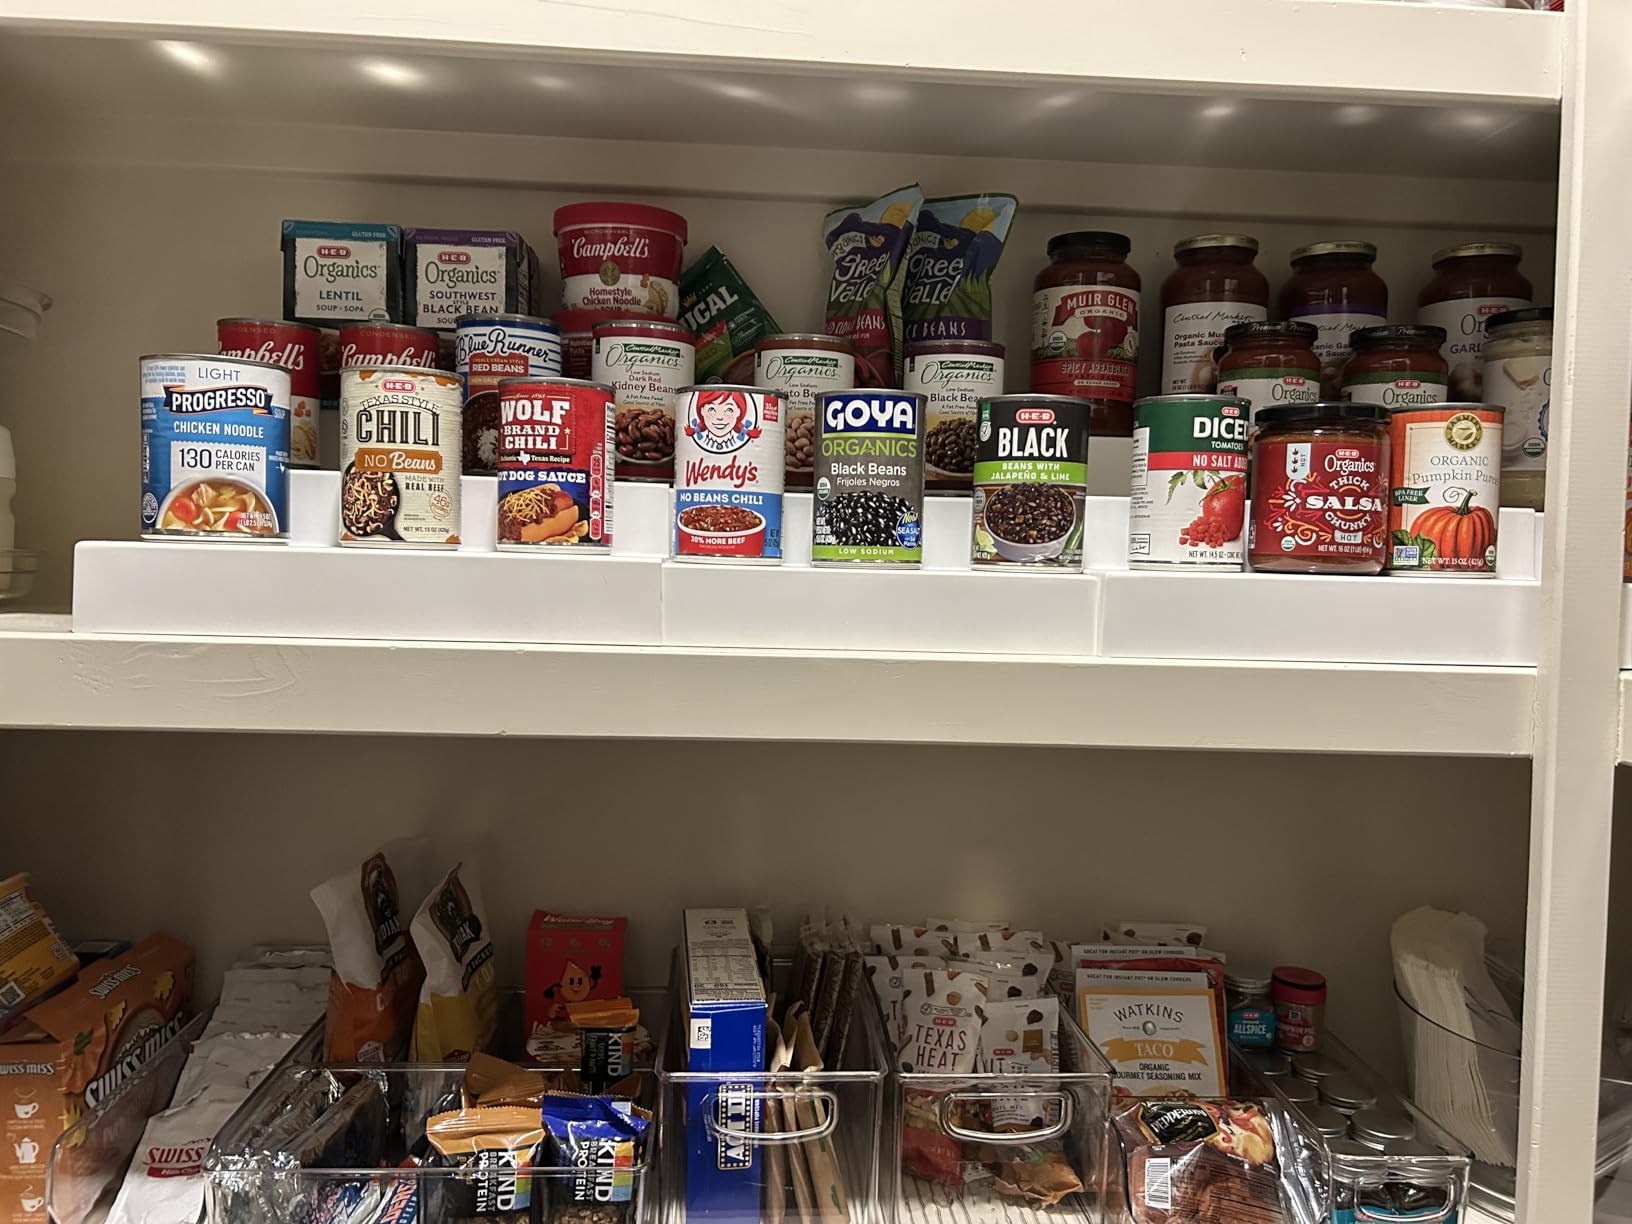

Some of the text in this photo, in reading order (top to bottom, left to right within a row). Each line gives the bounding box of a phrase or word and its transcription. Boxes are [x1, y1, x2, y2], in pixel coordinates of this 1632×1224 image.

[572, 236, 649, 260] Campbell's
[304, 256, 377, 283] Organics
[425, 262, 497, 288] Organics
[319, 290, 363, 301] LENTIL
[429, 290, 496, 300] SOUTHWEST
[590, 288, 632, 298] Homestyle
[316, 304, 338, 312] SOUP
[423, 304, 498, 314] BLACK BEAN
[582, 297, 642, 306] Chicken Noodle
[1067, 294, 1134, 315] MUIR GLEN
[1080, 308, 1124, 318] ORGANIC
[1174, 312, 1254, 324] Central Market
[922, 321, 966, 337] BEANS
[1174, 332, 1205, 340] Organic
[456, 328, 550, 366] Blue Runner
[1174, 340, 1195, 348] Pasta
[606, 344, 678, 372] Organics
[1325, 350, 1352, 358] Sauce
[198, 367, 240, 382] LIGHT
[472, 364, 524, 374] RED BEANS
[766, 357, 838, 384] Organics
[921, 362, 992, 388] Organics
[1062, 362, 1086, 374] SPICY
[612, 381, 646, 393] Kidney
[1272, 384, 1318, 404] Organics
[172, 387, 266, 412] PROGRESSO
[360, 395, 440, 413] TEXAS STYLE
[930, 393, 958, 402] Black
[1383, 388, 1436, 406] Organics
[500, 400, 570, 425] WOLF
[826, 400, 913, 430] GOYA
[1020, 412, 1050, 420] H-E-B
[174, 421, 264, 439] CHICKEN NOODLE
[356, 410, 440, 446] CHILI
[504, 424, 560, 436] BRAND
[1446, 414, 1480, 431] FARMERS
[505, 436, 558, 450] CHILI
[822, 439, 917, 458] ORGANICS
[998, 427, 1069, 458] BLACK
[1211, 441, 1244, 450] TOMATOES
[1448, 436, 1479, 450] MARKET
[179, 448, 212, 469] 130
[215, 449, 261, 462] CALORIES
[364, 452, 436, 470] NO Beans
[1193, 455, 1232, 468] NO SALT
[1430, 456, 1488, 466] ORGANIC
[215, 460, 255, 472] PER CAN
[686, 455, 758, 488] Wendy's
[831, 462, 907, 476] Black Beans
[1002, 462, 1032, 470] BEANS
[1325, 454, 1375, 476] Organics
[509, 471, 586, 484] DOG SAUCE
[991, 470, 1036, 480] JALAPEÑO
[1412, 469, 1472, 484] Pumpkin
[406, 482, 444, 492] REAL BEEF
[836, 478, 900, 488] Frijoles Negros
[1330, 476, 1370, 490] THICK
[680, 492, 763, 504] NO BEANS CHILI
[1306, 496, 1382, 512] SALSA
[1325, 512, 1372, 530] CHUNKY
[898, 526, 910, 534] SEA
[690, 536, 704, 544] 30%
[706, 536, 726, 544] MORE
[1114, 1003, 1184, 1024] WATKINS
[1234, 1024, 1266, 1034] ALLSPICE
[915, 1024, 967, 1051] TEXAS
[608, 1032, 622, 1076] KIND
[1134, 1043, 1174, 1058] TACO
[916, 1046, 960, 1072] HEAT
[1139, 1063, 1170, 1071] ORGANIC
[1146, 1072, 1202, 1081] SEASONING MIX
[143, 1147, 205, 1166] SWISS
[574, 1141, 590, 1200] PROTEIN
[586, 1141, 598, 1201] BREAKFAST
[595, 1141, 616, 1202] KIND
[476, 1152, 488, 1212] PROTEIN
[487, 1152, 498, 1212] BREAKFAST
[497, 1151, 518, 1211] KIND
